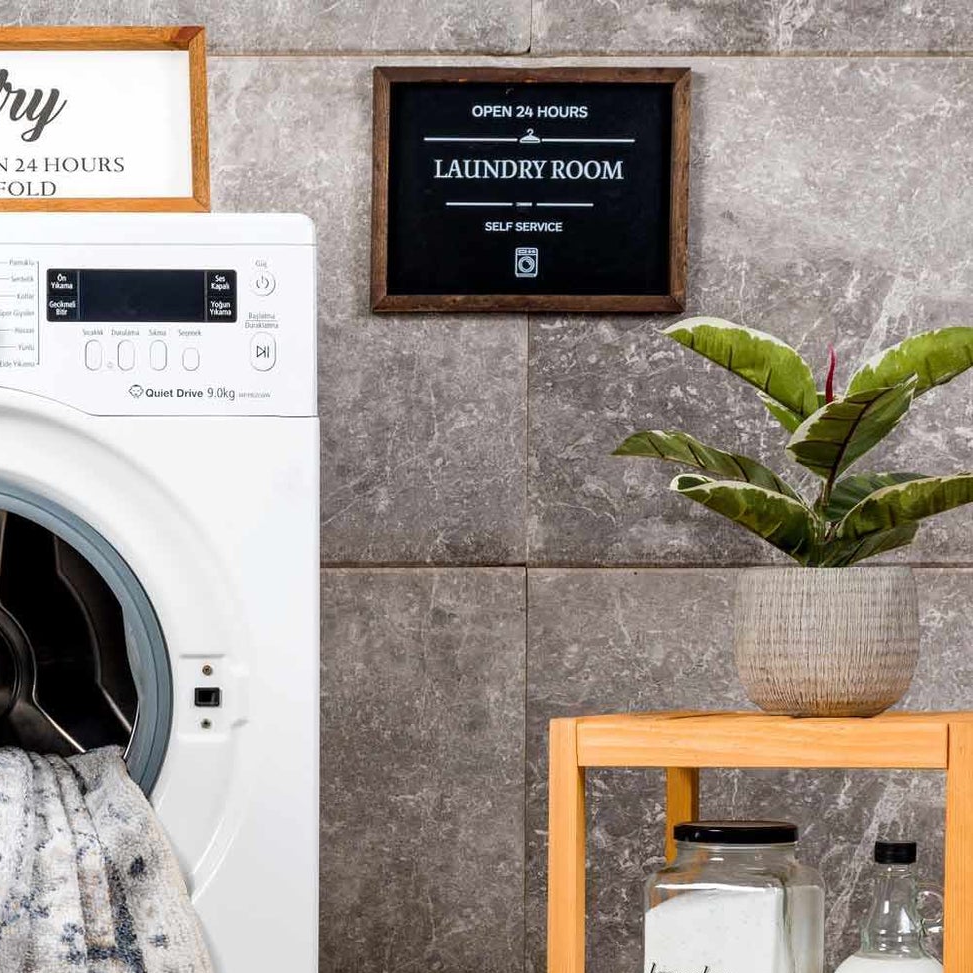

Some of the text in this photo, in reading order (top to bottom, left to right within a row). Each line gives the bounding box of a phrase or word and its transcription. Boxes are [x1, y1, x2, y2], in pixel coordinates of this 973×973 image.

[471, 105, 588, 118] OPEN 24 HOURS
[15, 158, 38, 173] 24
[44, 157, 125, 173] HOURS
[434, 159, 624, 180] LAUNDRY ROOM
[484, 221, 563, 232] SELF SERVICE
[56, 273, 67, 282] Ön
[214, 274, 226, 283] Ses
[210, 301, 231, 310] Yoğun
[145, 388, 174, 398] Quiet
[176, 388, 204, 398] Drive
[207, 387, 236, 401] 9.0kg
